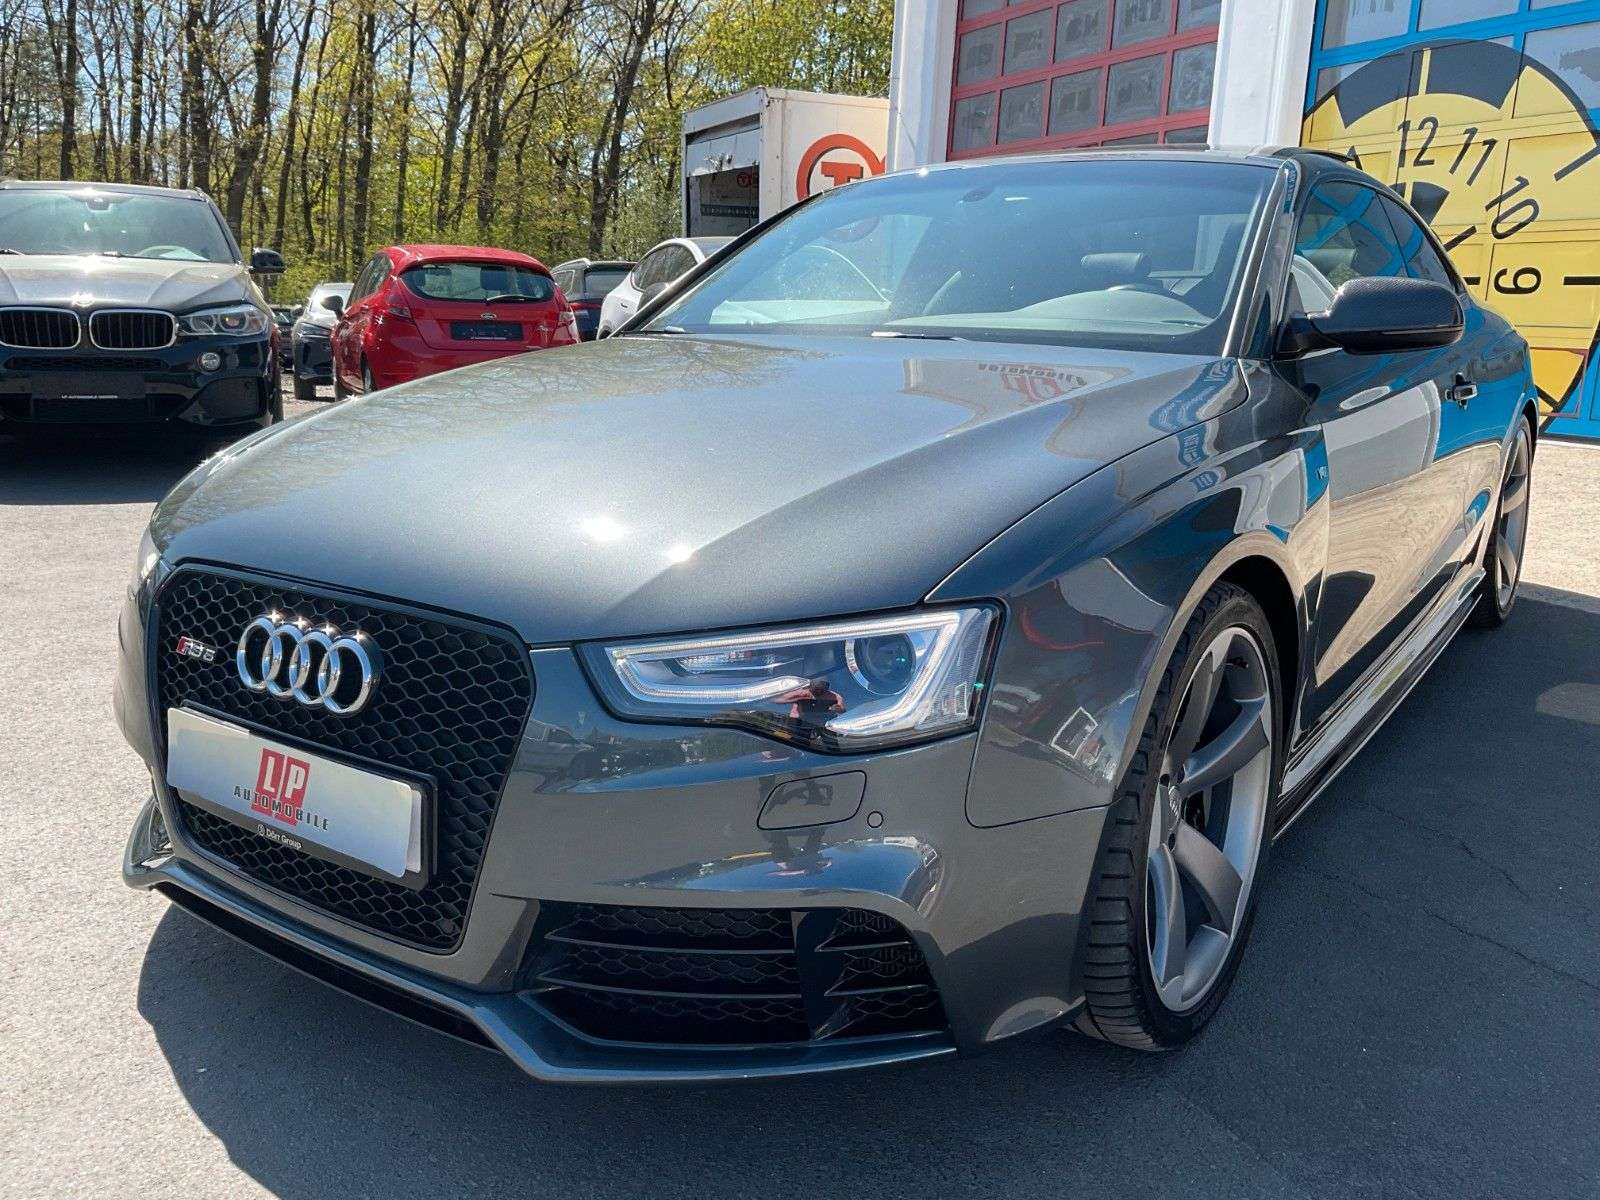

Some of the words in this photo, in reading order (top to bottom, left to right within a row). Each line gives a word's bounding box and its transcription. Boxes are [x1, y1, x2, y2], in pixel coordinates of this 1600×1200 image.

[1397, 116, 1439, 168] 12
[1449, 126, 1498, 187] 11
[1484, 175, 1541, 240] 10
[262, 755, 307, 799] LP
[233, 785, 329, 831] AUTOMOBILE
